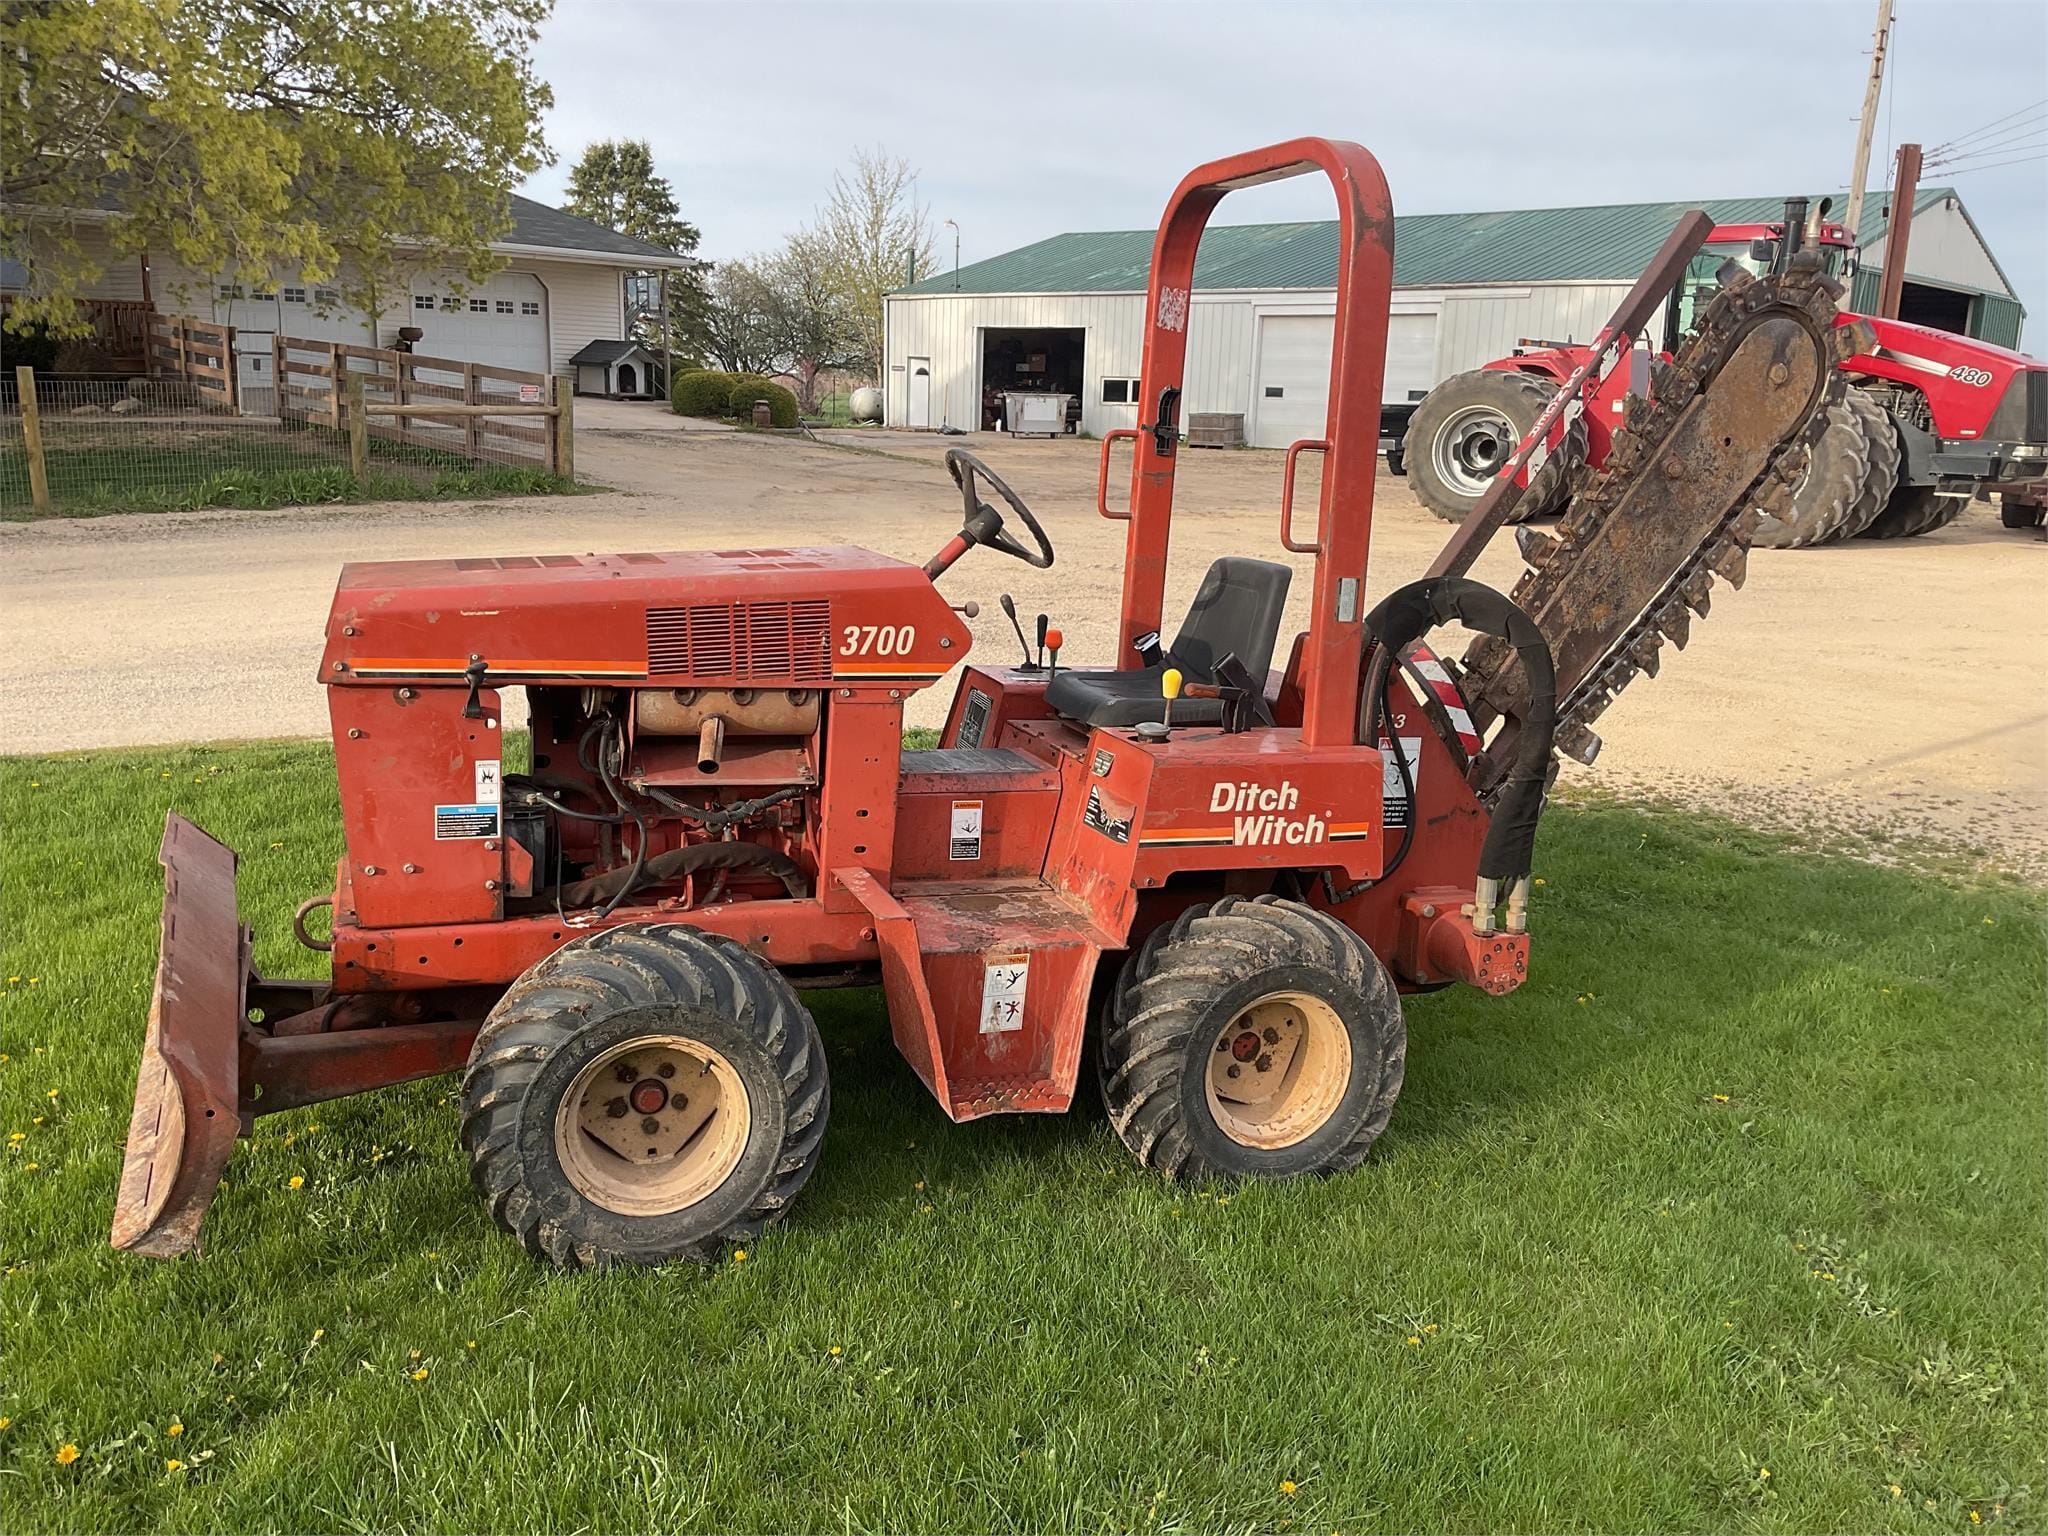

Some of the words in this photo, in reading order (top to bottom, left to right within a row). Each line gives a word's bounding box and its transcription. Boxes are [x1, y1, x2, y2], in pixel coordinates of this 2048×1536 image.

[1950, 365, 1992, 387] 480
[1527, 366, 1584, 438] DANGER
[840, 625, 915, 655] 3700
[1209, 781, 1299, 812] Ditch
[1234, 814, 1325, 846] Witch
